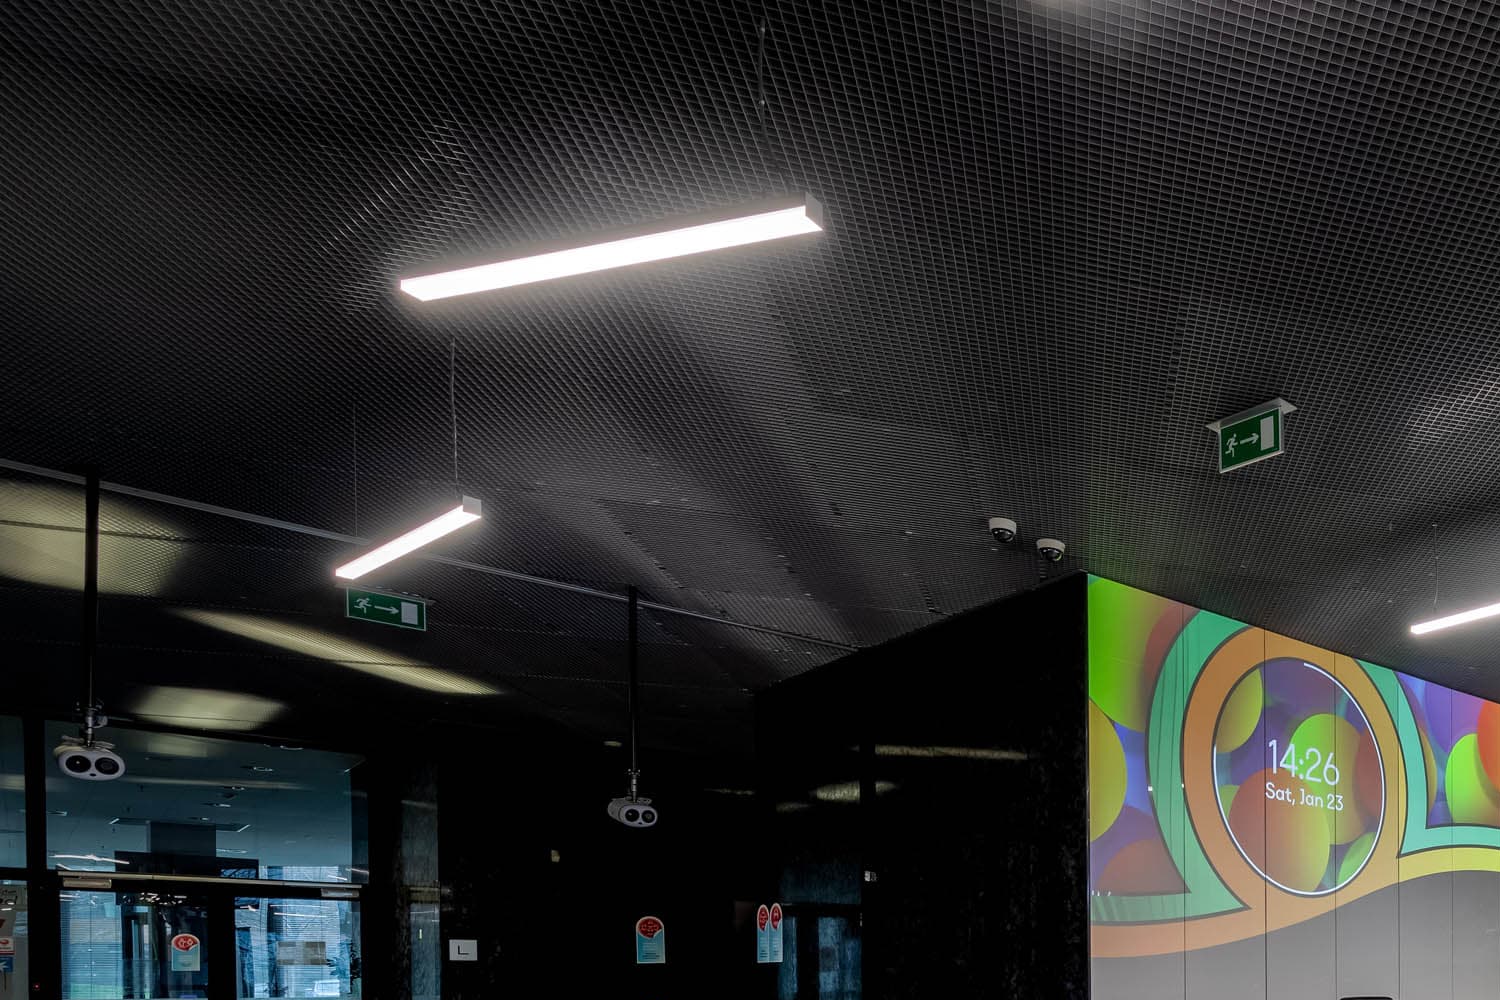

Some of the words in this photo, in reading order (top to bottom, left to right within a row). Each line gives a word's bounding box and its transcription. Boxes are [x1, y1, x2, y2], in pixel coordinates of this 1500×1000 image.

[1268, 739, 1340, 786] 14:26
[1265, 782, 1297, 806] Sat,
[1299, 788, 1324, 808] Jan
[1326, 793, 1344, 811] 23
